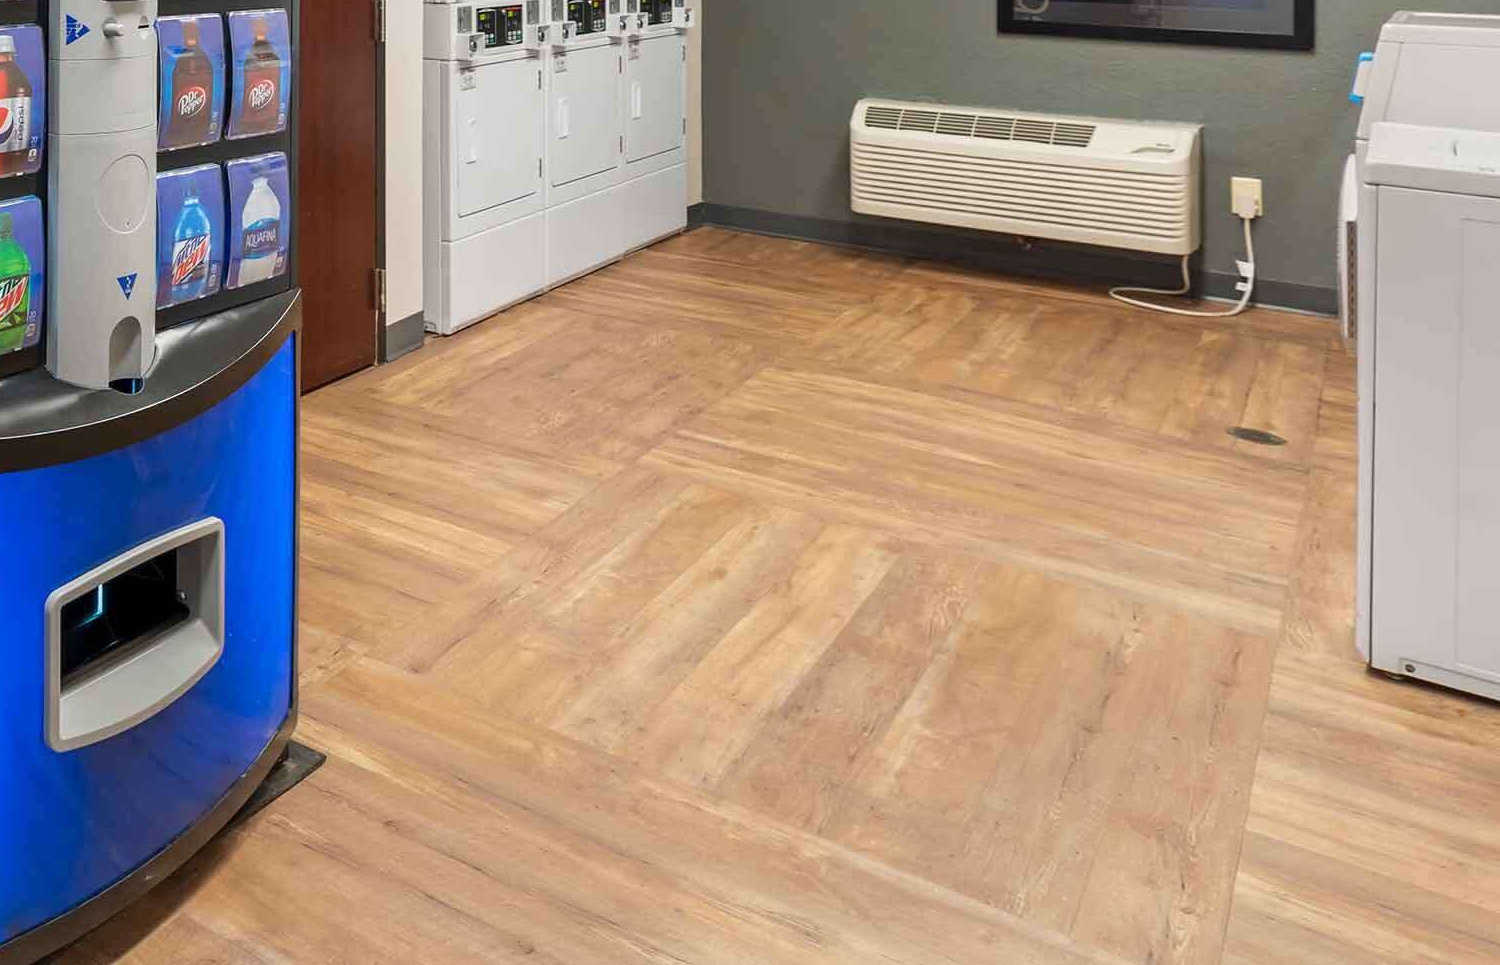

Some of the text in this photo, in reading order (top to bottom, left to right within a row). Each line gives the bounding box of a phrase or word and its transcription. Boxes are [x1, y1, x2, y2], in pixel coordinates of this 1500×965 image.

[187, 91, 198, 101] Dr
[178, 96, 205, 116] Pepper
[245, 228, 277, 247] AQUAFINA
